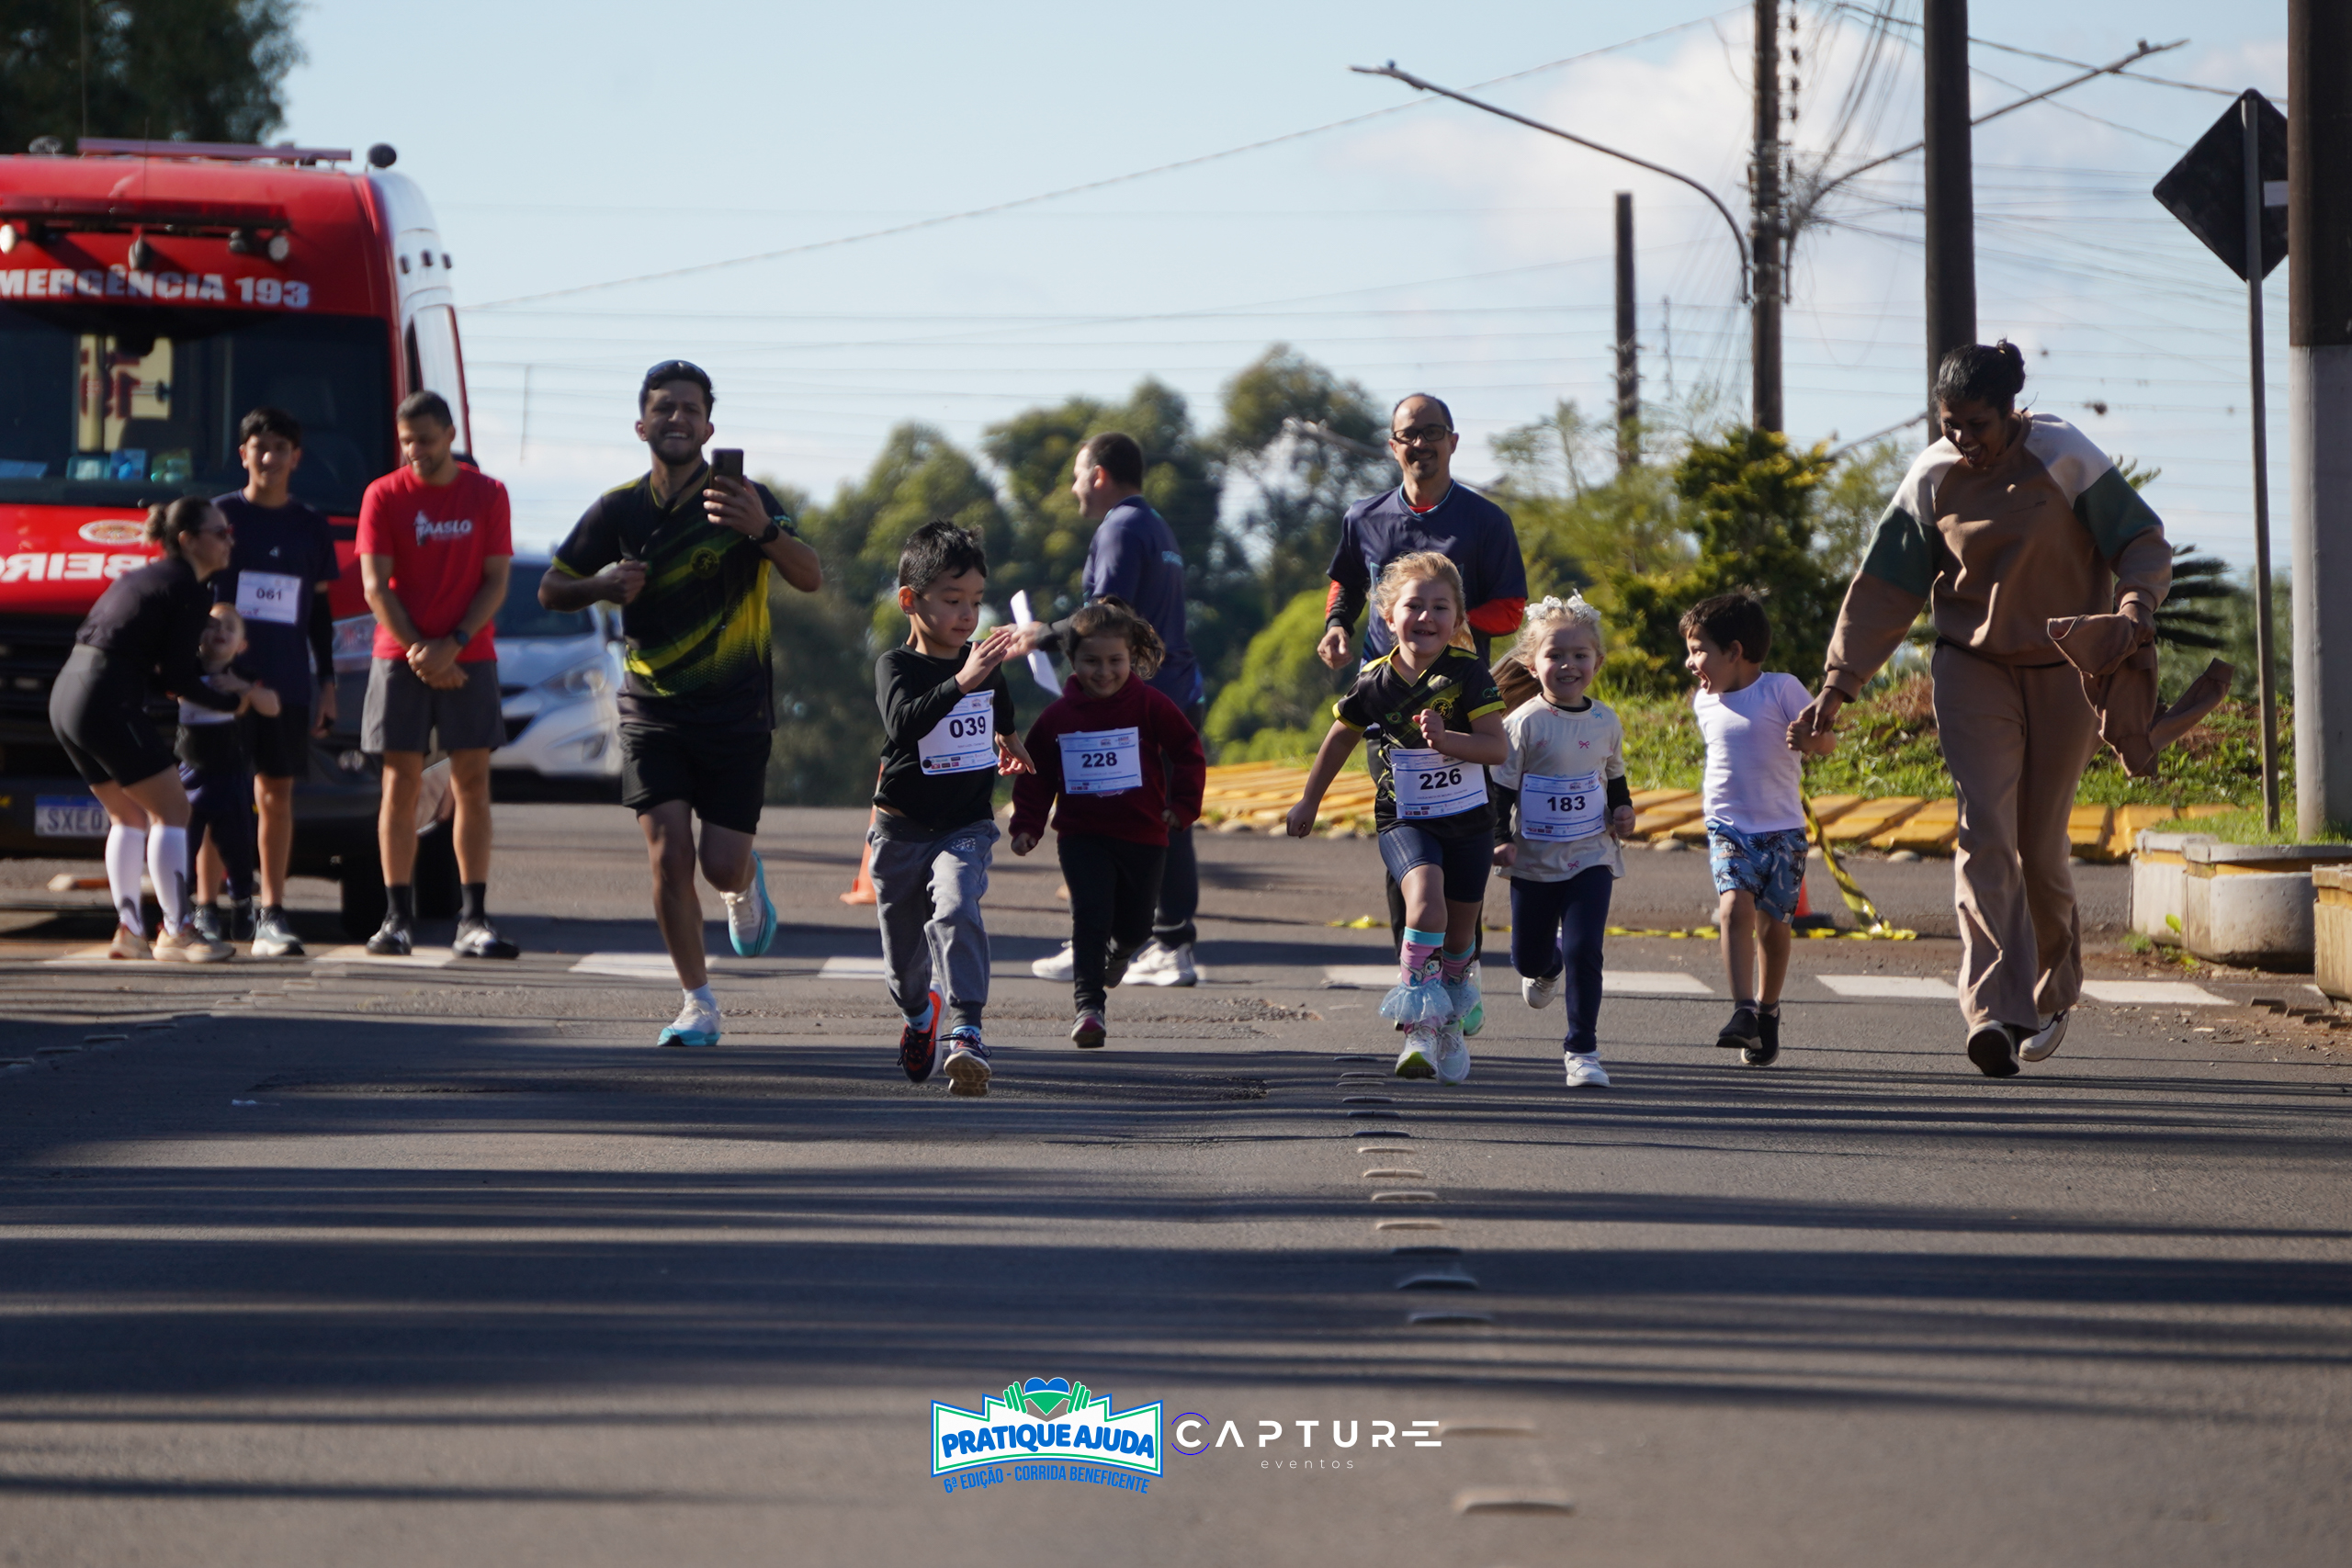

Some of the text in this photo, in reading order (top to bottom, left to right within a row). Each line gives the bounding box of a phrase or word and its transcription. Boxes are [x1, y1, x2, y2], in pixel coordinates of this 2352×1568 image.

[235, 276, 310, 309] 193
[256, 588, 282, 601] 061
[949, 716, 986, 739] 039
[1081, 751, 1117, 768] 228
[1419, 768, 1462, 791] 226
[1547, 795, 1586, 812] 183
[47, 808, 110, 832] SXE0
